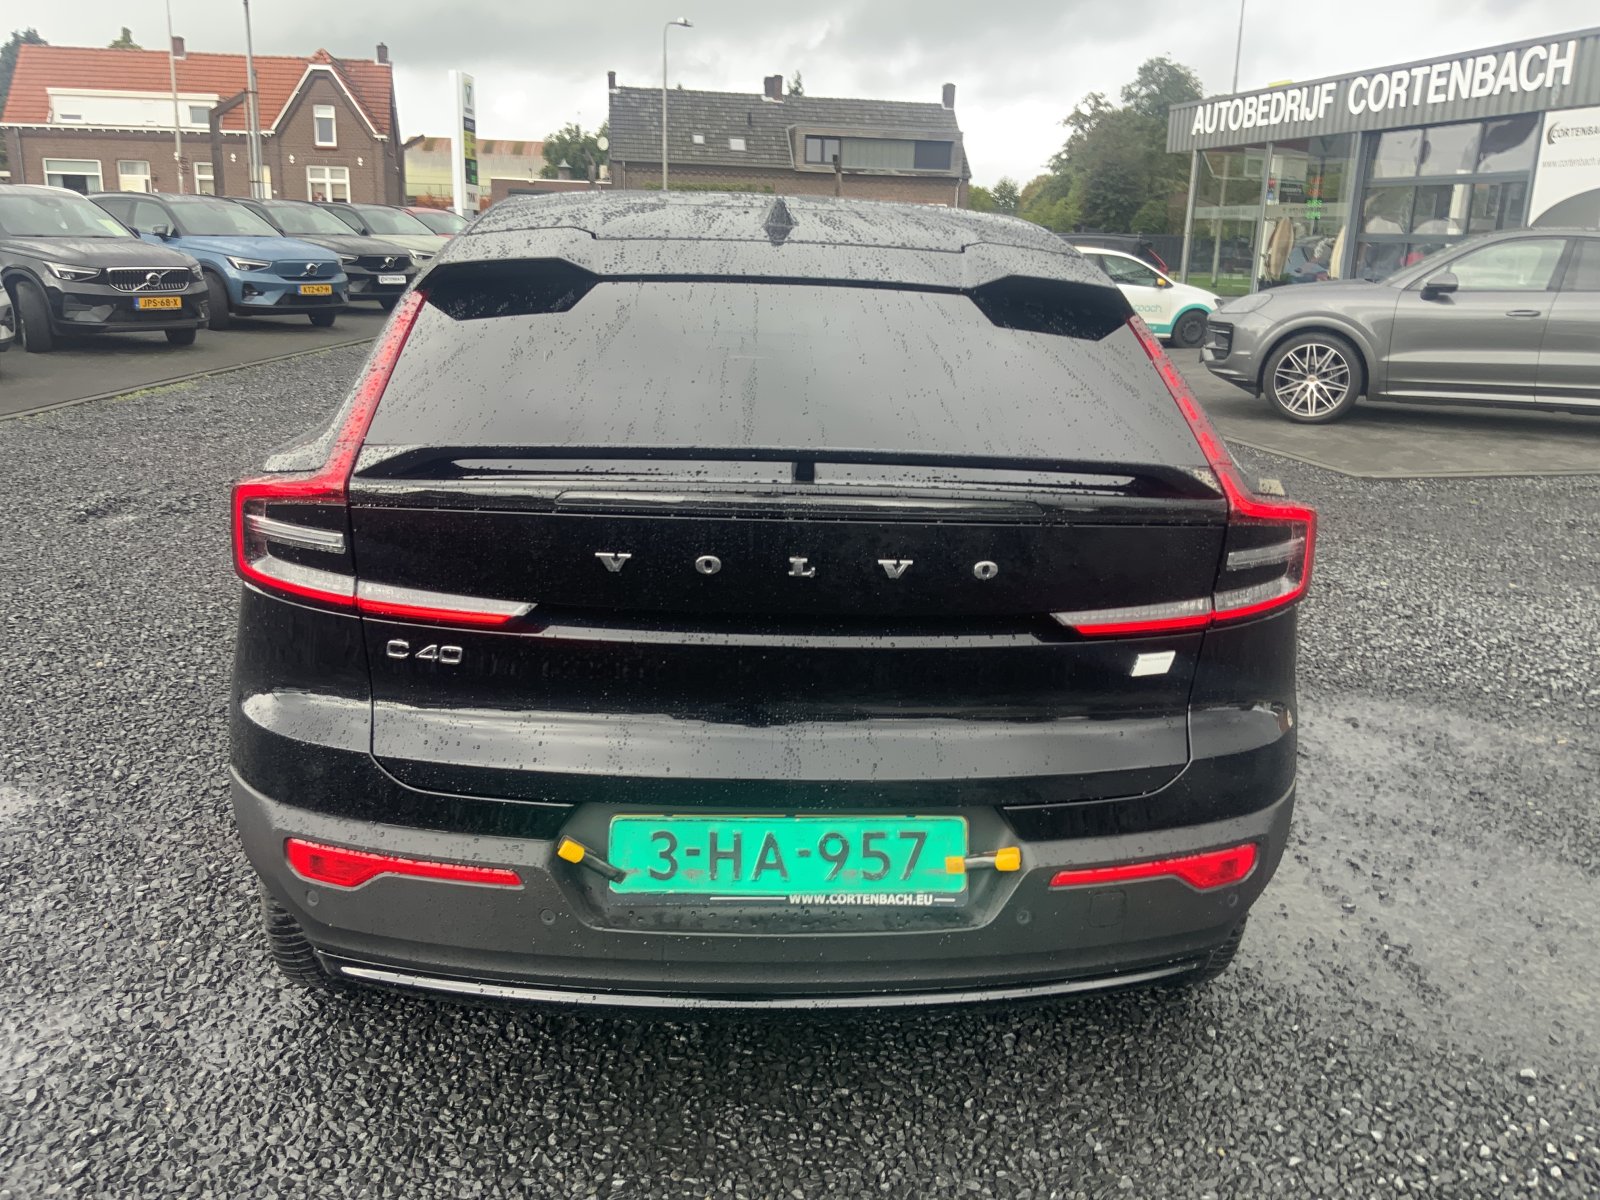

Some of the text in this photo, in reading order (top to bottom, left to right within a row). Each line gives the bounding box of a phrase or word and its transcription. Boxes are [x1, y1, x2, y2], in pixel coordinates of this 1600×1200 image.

[1191, 39, 1577, 135] AUTOBEDRIJF CORTENBACH
[142, 298, 179, 308] JPS-68-X
[594, 551, 999, 581] VOLVO
[648, 830, 929, 882] 3-HA-957
[788, 893, 934, 906] WWW.CORTENBACH.EU
